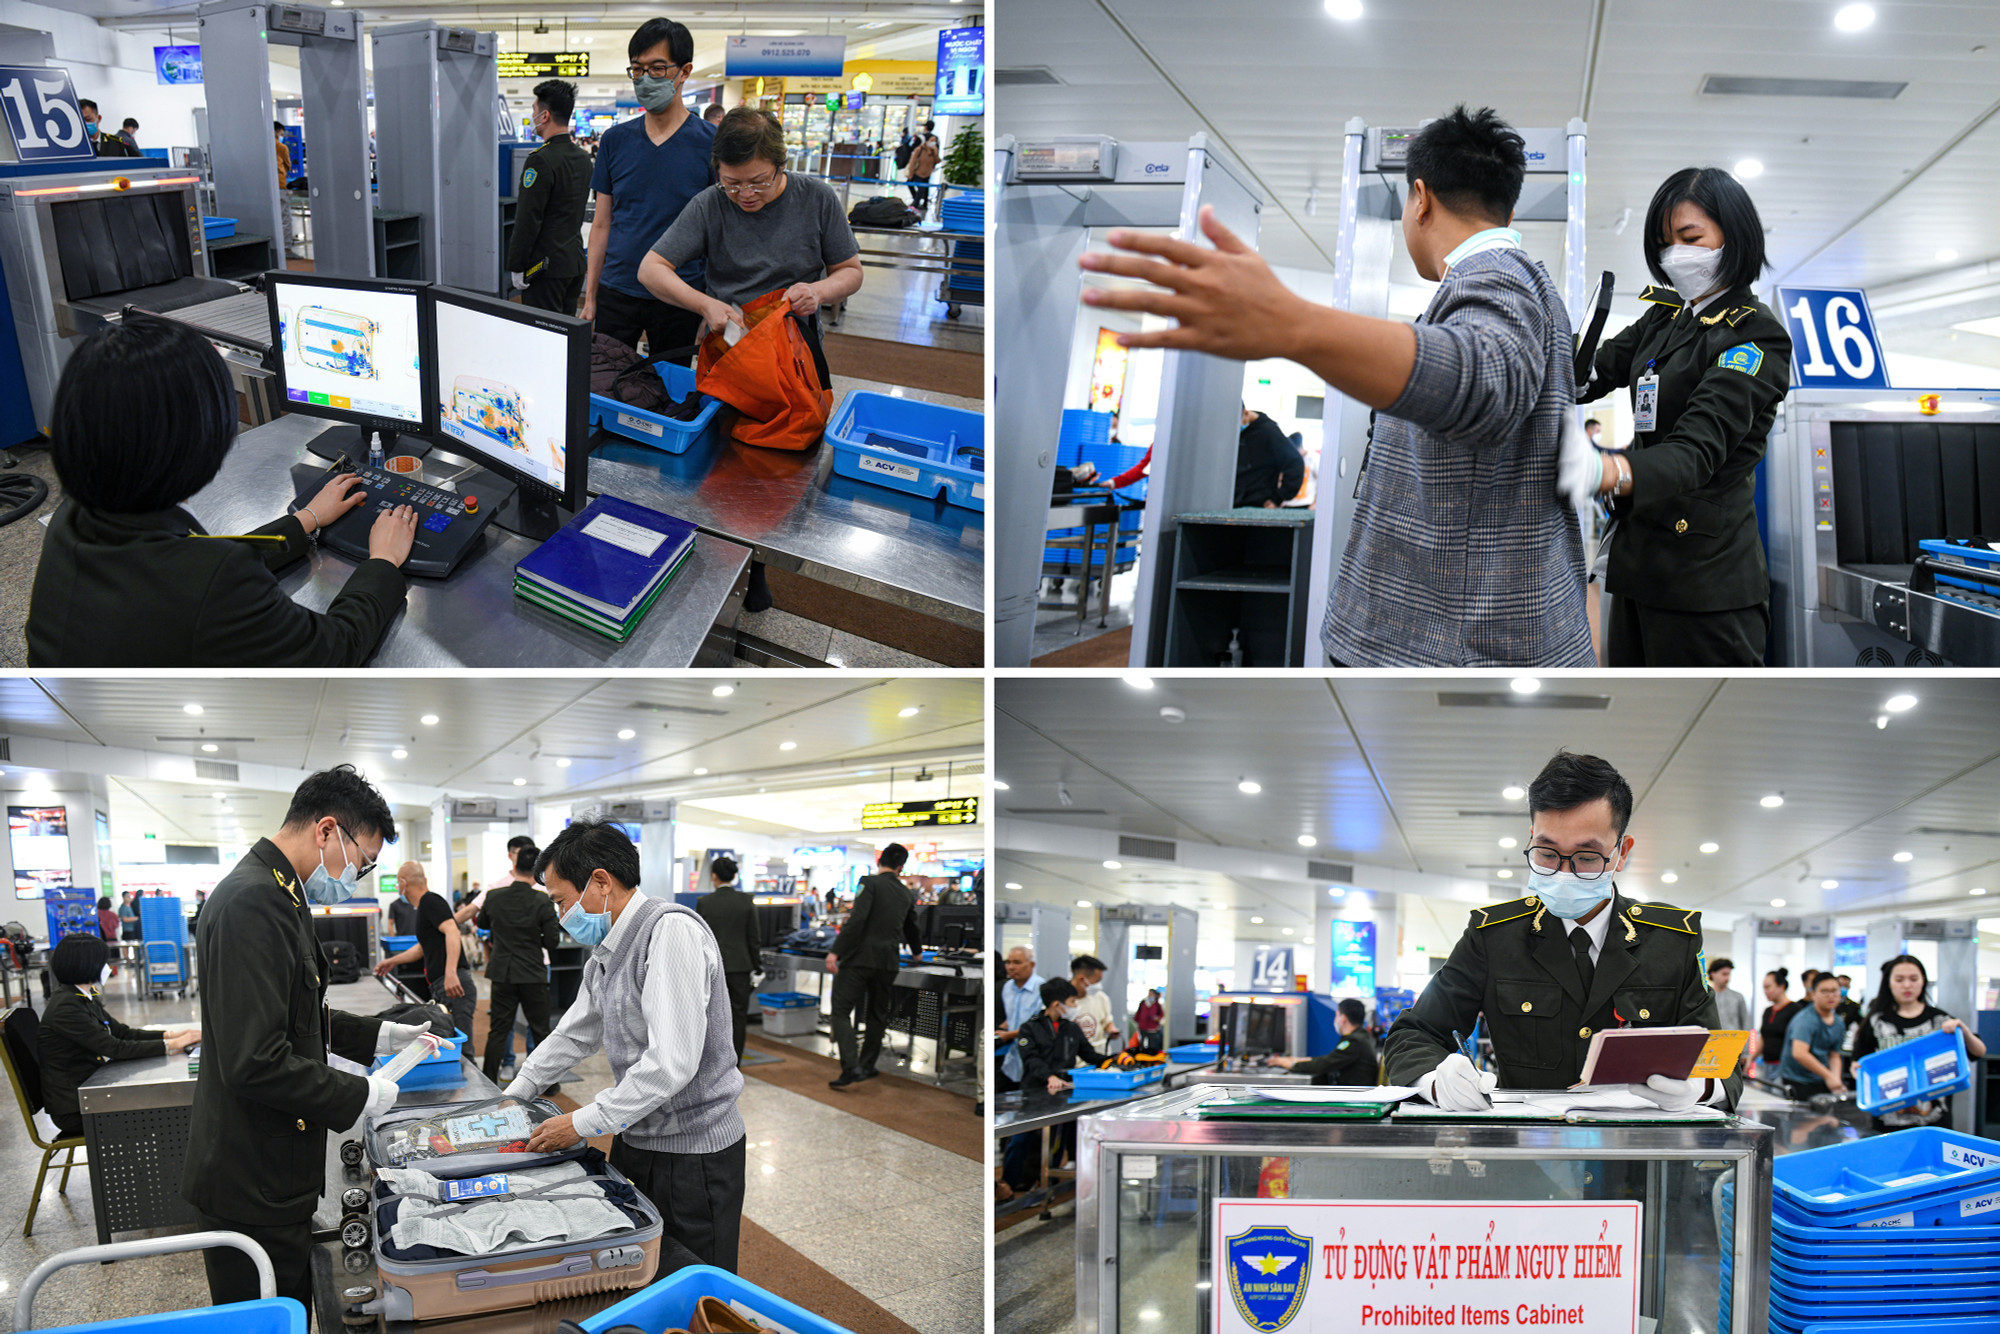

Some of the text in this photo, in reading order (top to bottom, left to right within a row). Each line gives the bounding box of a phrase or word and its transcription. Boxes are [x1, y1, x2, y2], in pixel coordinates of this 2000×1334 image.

[761, 49, 811, 57] 0912.525.070
[1, 78, 83, 149] 15
[1789, 296, 1875, 379] 16
[875, 462, 895, 472] ACV
[779, 876, 795, 893] 17
[1253, 950, 1288, 986] 14
[1963, 1152, 1985, 1168] ACV
[1974, 1198, 1993, 1209] ACV
[1322, 1219, 1623, 1290] TỦ ĐỰNG VẬT PHẨM NGUY HIỂM
[1243, 1281, 1296, 1293] AN NINH SÂN BAY
[1361, 1303, 1584, 1326] Prohibited Items Cabinet
